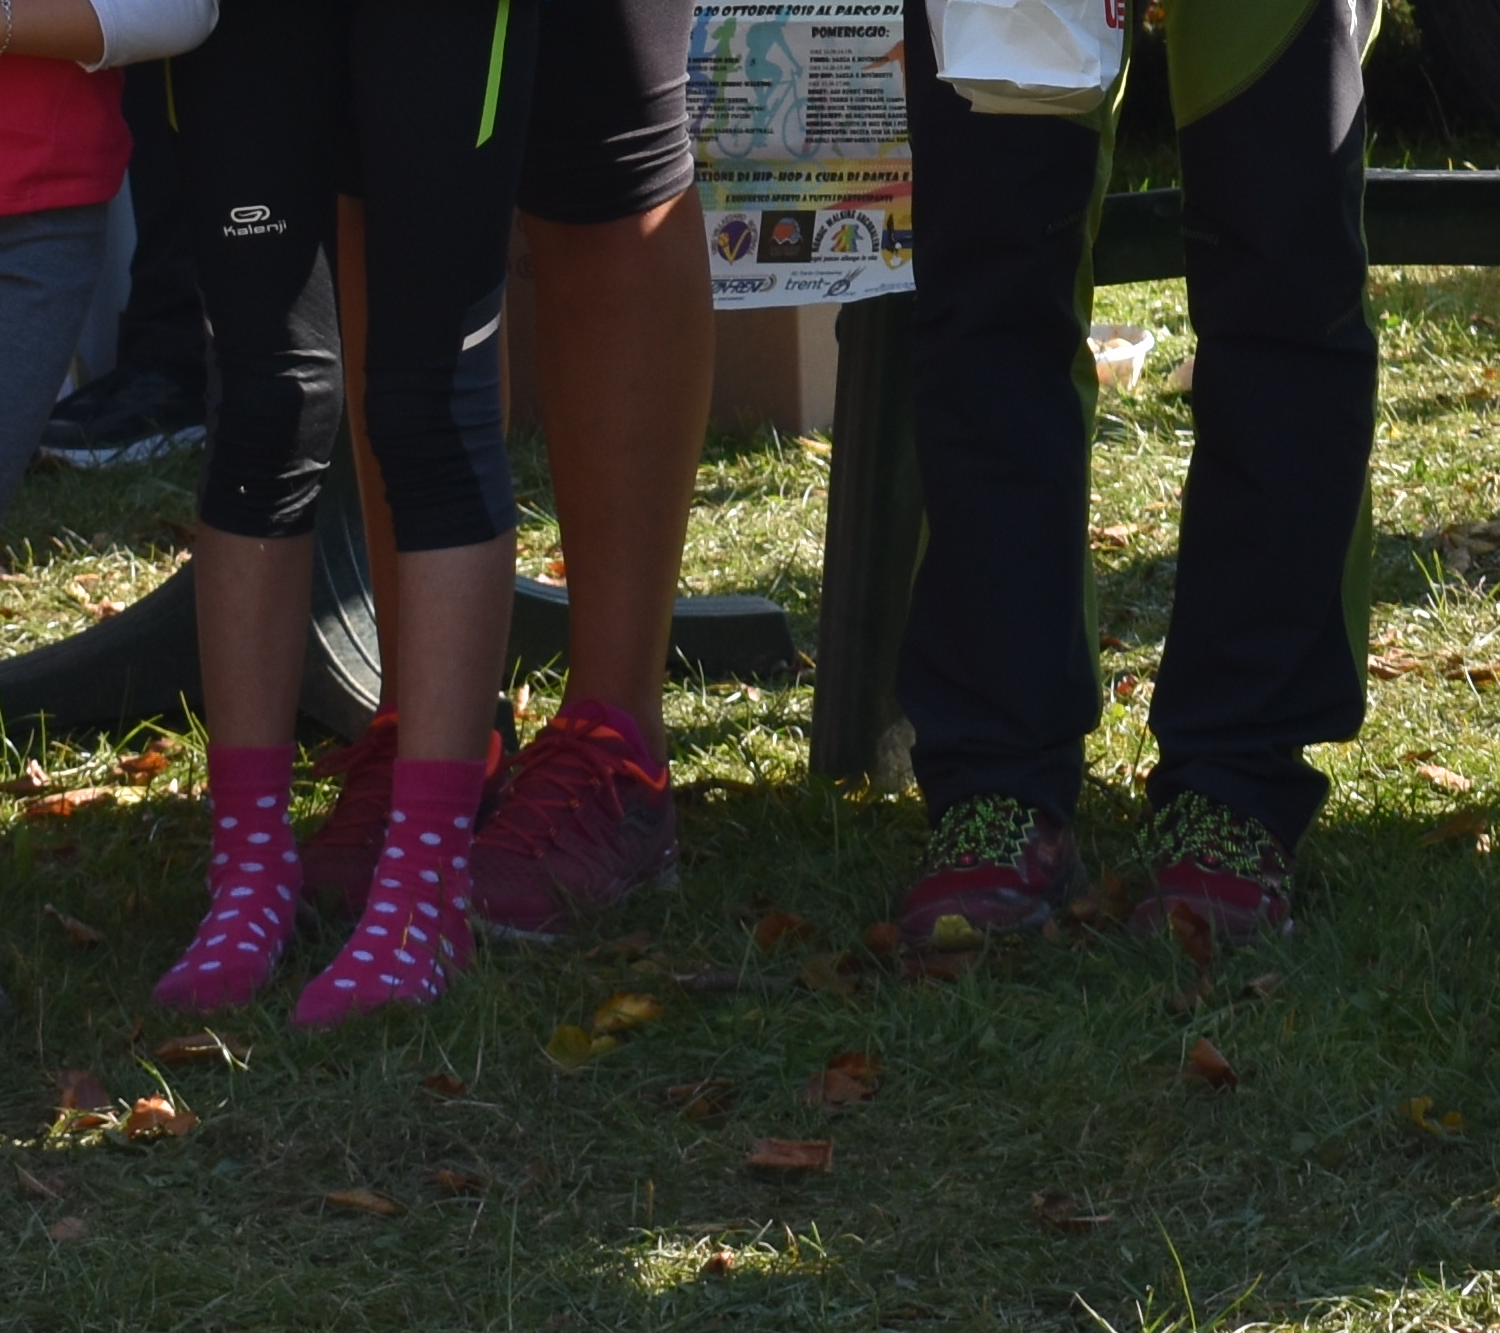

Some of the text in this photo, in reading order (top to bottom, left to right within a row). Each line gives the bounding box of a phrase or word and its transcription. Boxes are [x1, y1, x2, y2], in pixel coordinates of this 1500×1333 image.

[722, 5, 780, 16] OTTOBRE
[785, 5, 814, 16] 2018
[815, 6, 832, 16] AL
[835, 5, 879, 16] PARCO
[882, 6, 898, 16] DI
[812, 26, 890, 38] POMERIGGIO:
[752, 171, 802, 181] HIP-HOP
[806, 171, 812, 181] A
[815, 171, 844, 181] CURA
[846, 171, 859, 181] DI
[862, 171, 899, 181] DANZA
[223, 220, 287, 237] Kalenji
